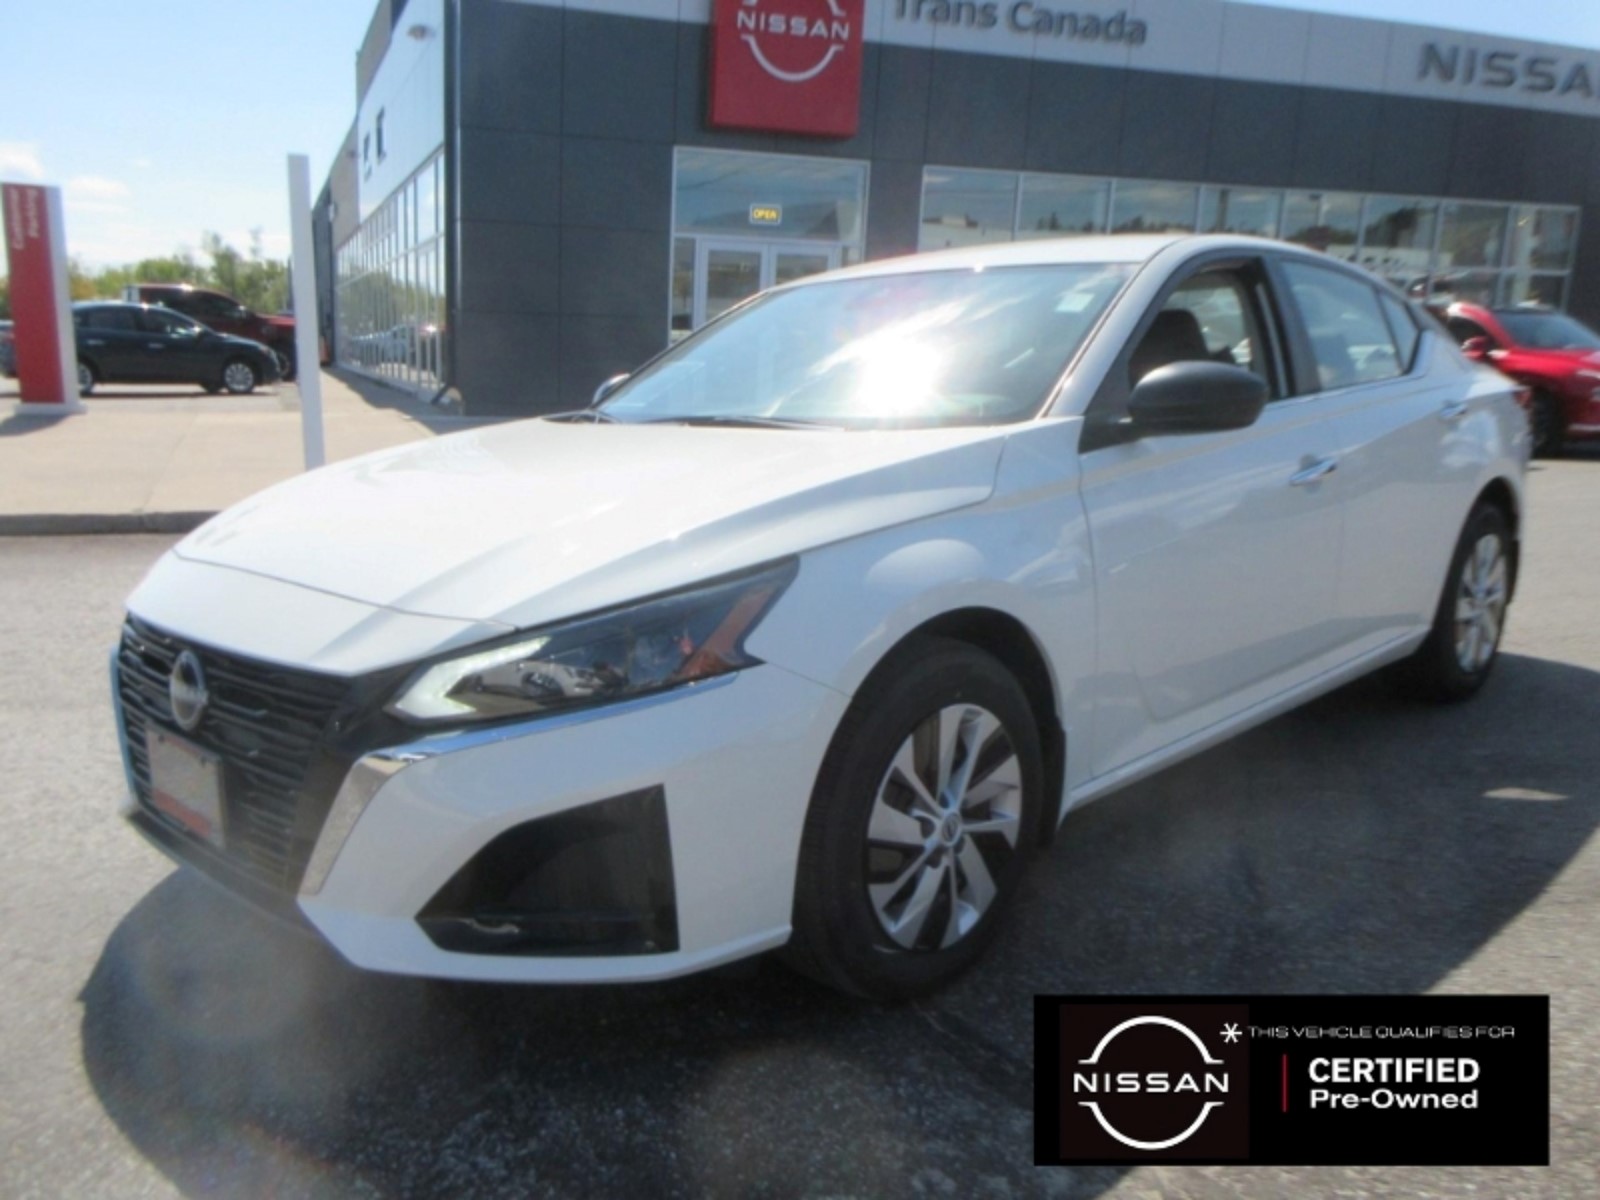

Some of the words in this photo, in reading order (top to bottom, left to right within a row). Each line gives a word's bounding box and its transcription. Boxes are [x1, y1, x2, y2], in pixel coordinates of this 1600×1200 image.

[737, 10, 850, 41] NISSAN
[1007, 0, 1148, 47] Canada
[1417, 42, 1600, 99] NISSA
